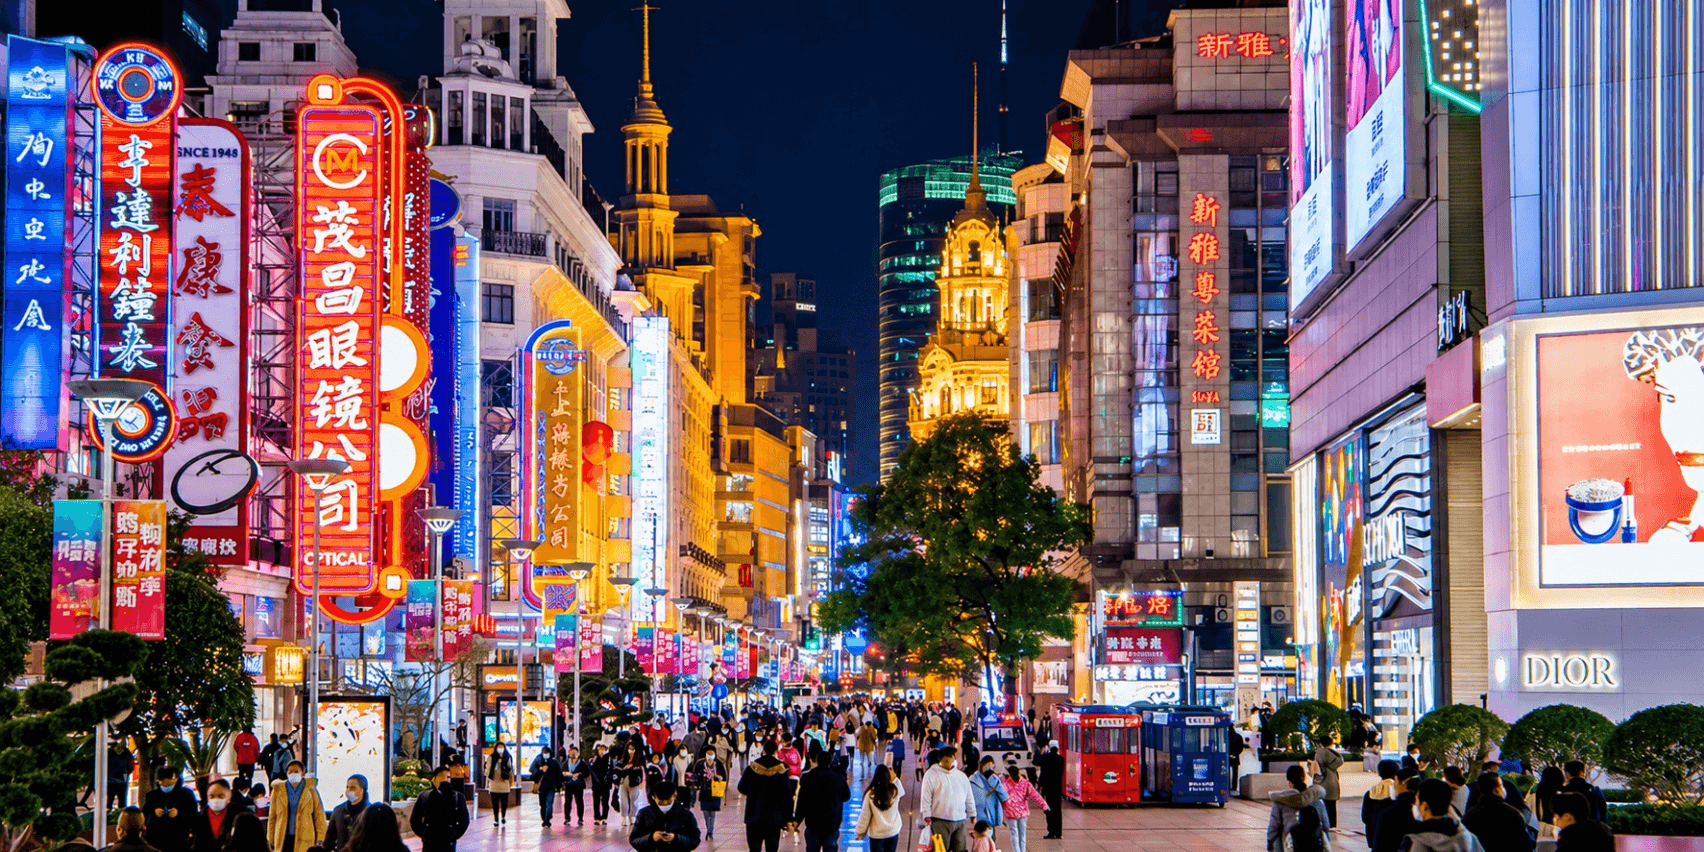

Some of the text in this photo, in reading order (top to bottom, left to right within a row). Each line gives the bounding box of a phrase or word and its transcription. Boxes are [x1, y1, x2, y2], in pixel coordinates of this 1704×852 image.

[1198, 31, 1290, 59] 新雅
[212, 147, 239, 158] 1948
[1524, 655, 1617, 686] DIOR
